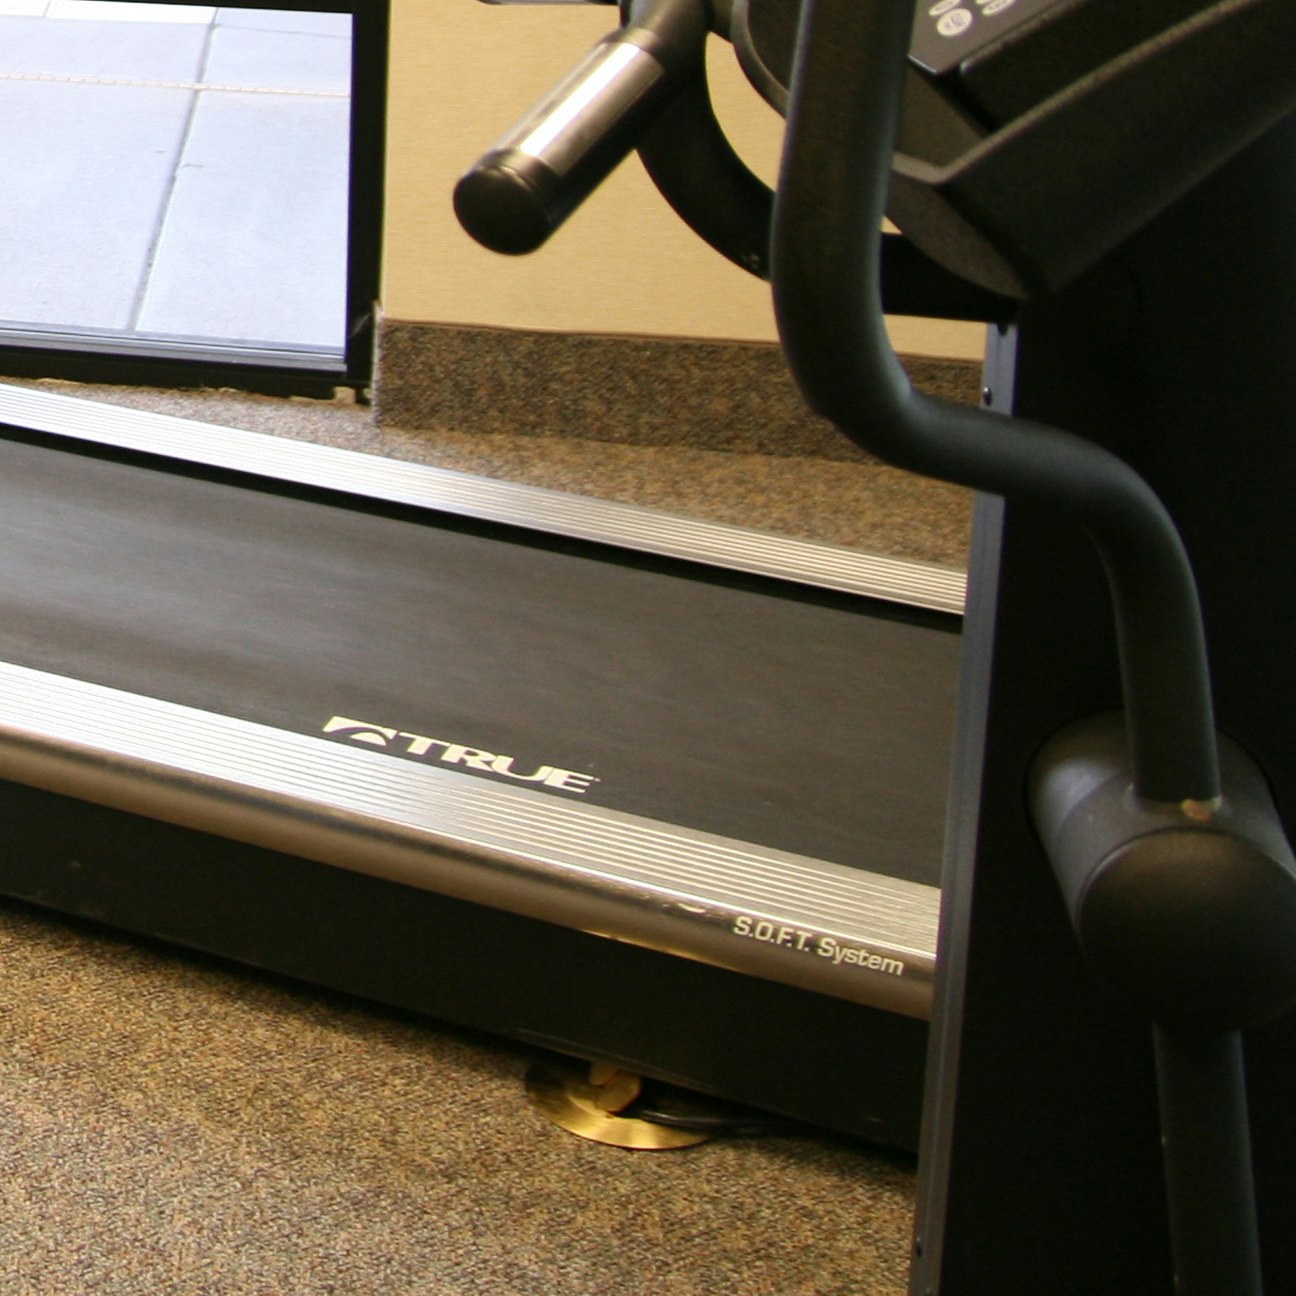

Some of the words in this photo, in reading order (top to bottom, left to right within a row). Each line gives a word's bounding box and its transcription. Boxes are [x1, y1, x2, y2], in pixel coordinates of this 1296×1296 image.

[398, 731, 595, 794] TRUE
[733, 915, 812, 952] S.O.F.T.
[816, 936, 905, 976] System
